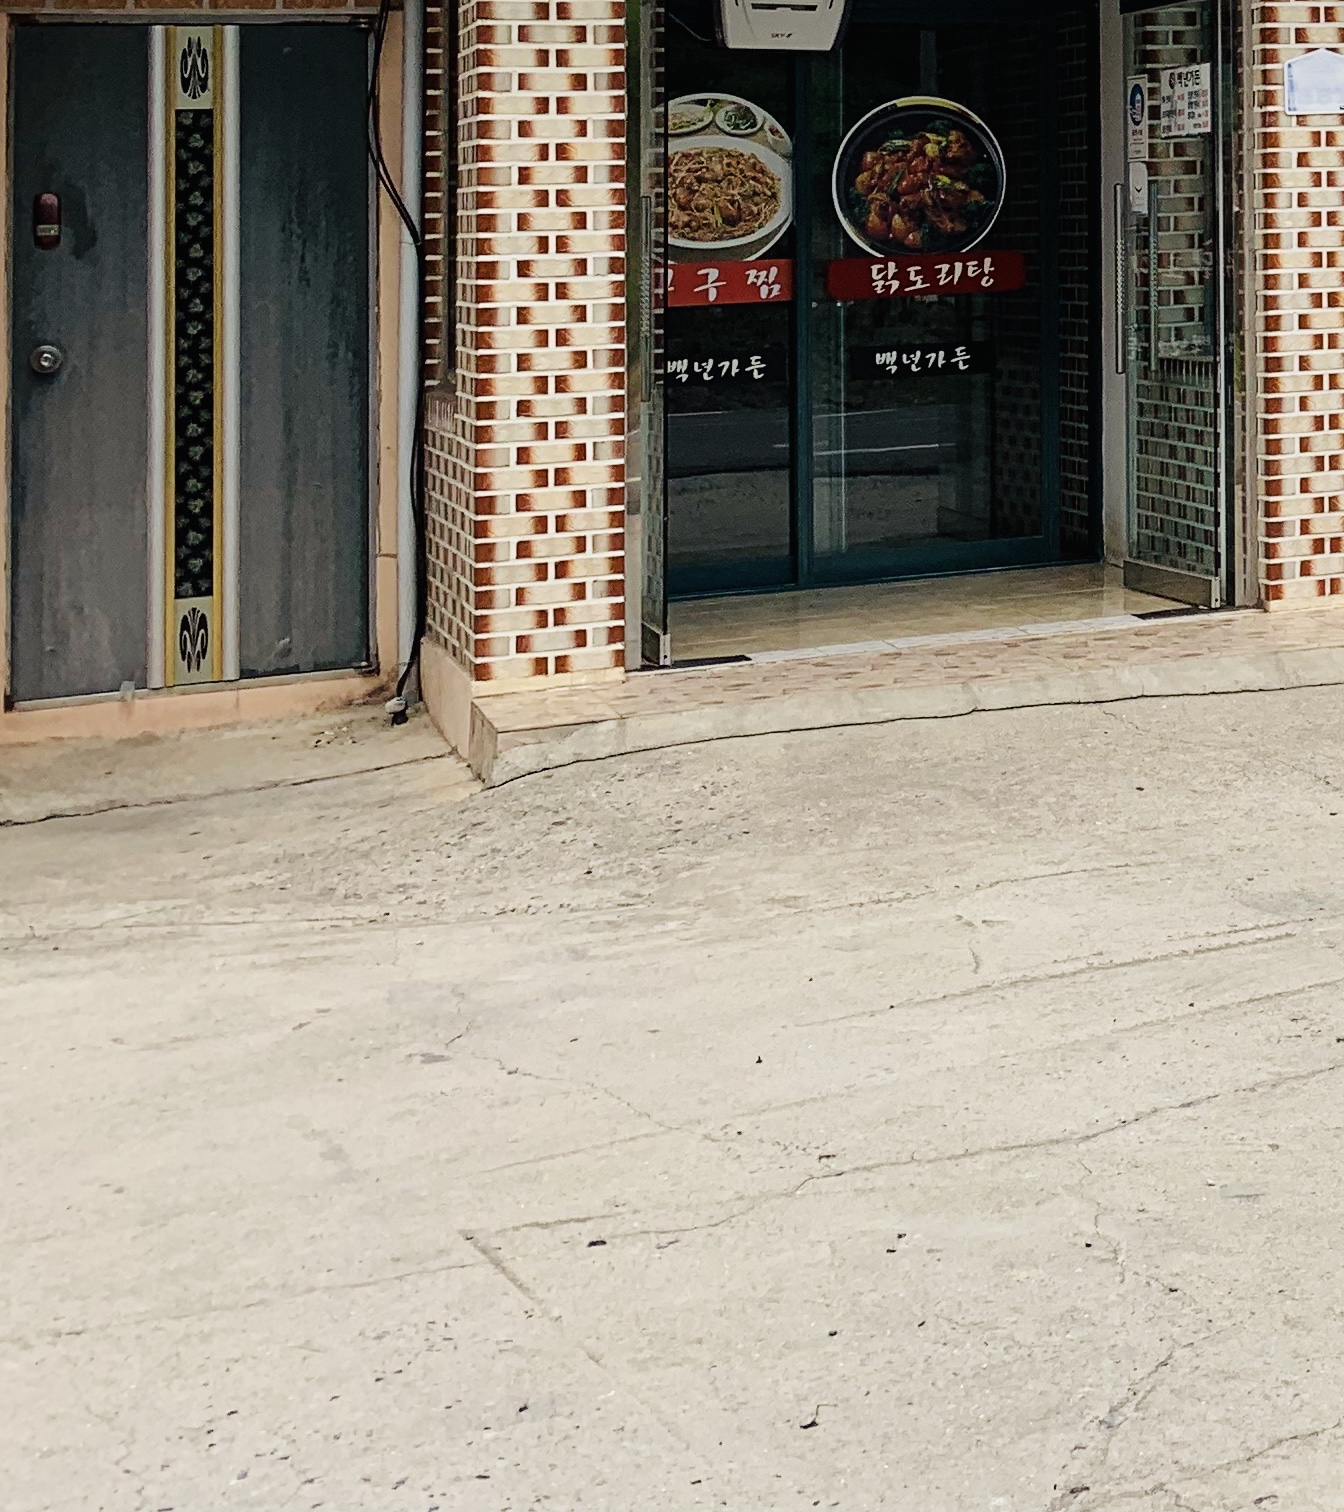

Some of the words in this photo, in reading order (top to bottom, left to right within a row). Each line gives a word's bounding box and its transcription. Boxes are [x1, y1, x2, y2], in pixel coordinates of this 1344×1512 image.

[668, 266, 782, 302] 구찜
[870, 257, 995, 295] 닭도리탕
[667, 355, 767, 383] 백년가든
[875, 346, 971, 374] 백년가든
